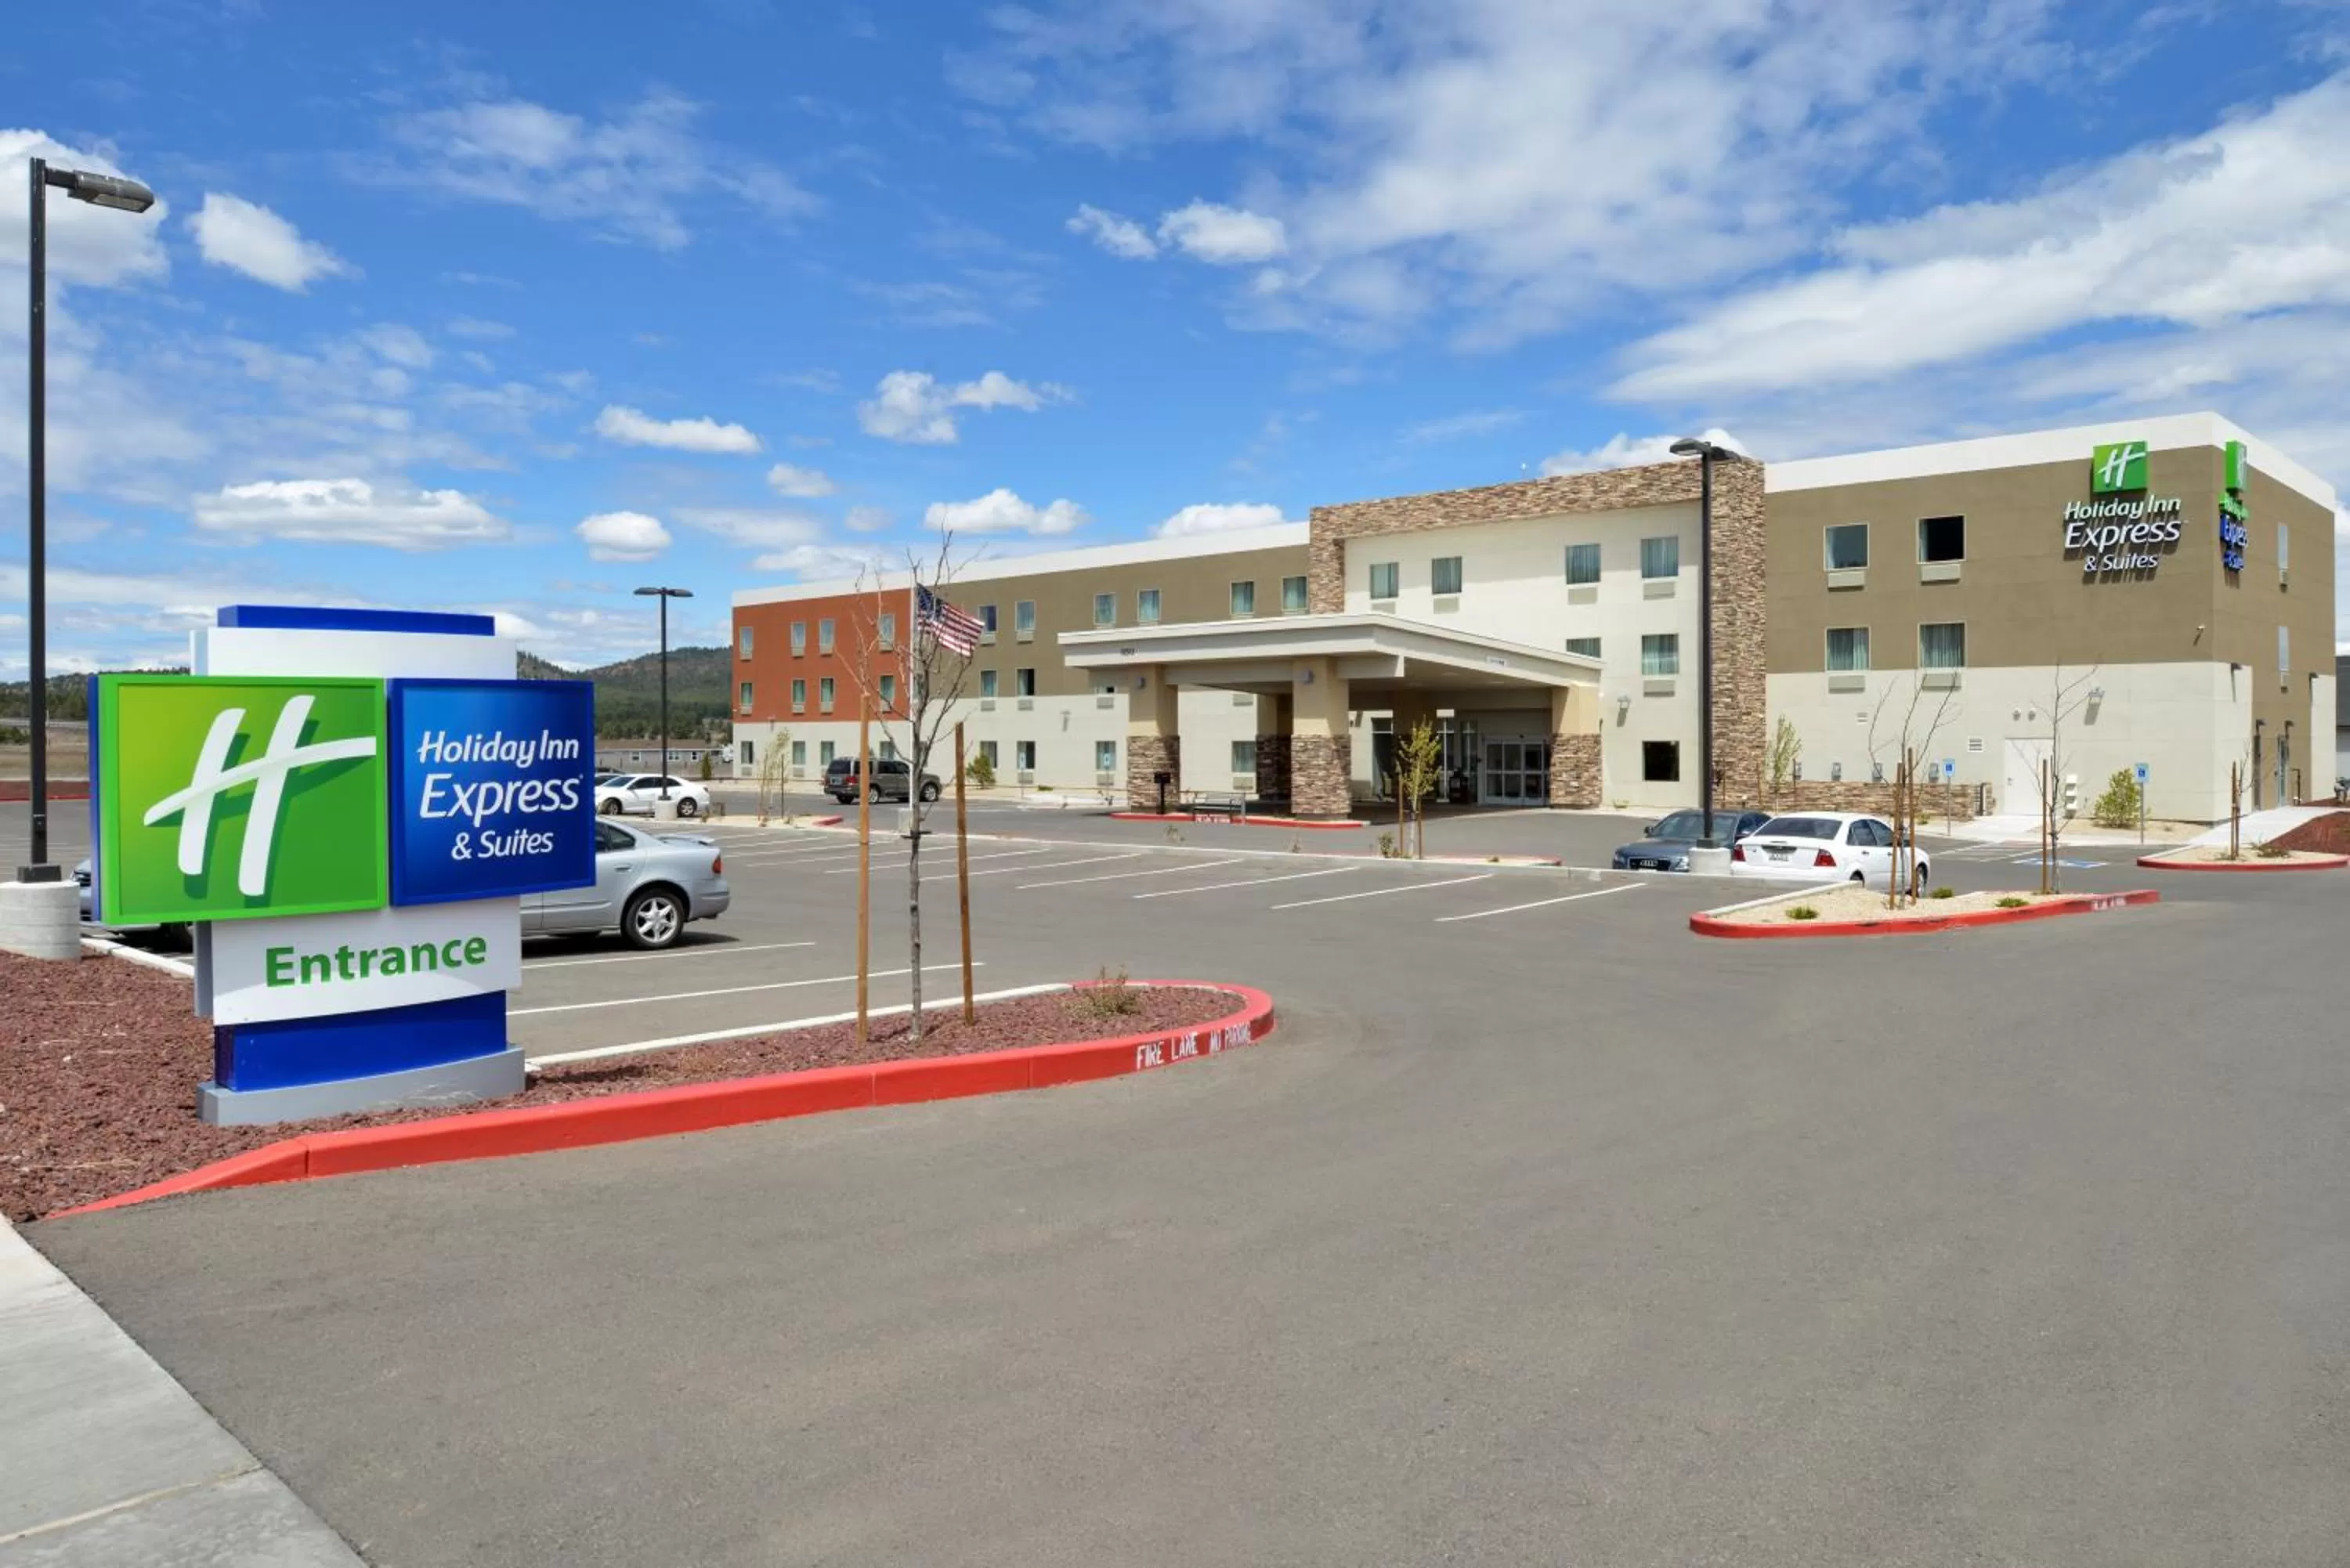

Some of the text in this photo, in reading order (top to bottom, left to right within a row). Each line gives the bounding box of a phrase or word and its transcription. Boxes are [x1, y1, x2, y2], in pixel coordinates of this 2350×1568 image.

[2063, 494, 2182, 520] Holiday Inn
[2064, 520, 2182, 553] Express
[2084, 552, 2158, 572] & Suites
[417, 729, 579, 768] Holiday Inn
[419, 772, 580, 828] Express
[450, 828, 554, 861] & Suites
[266, 937, 486, 988] Entrance
[1137, 1041, 1165, 1070] FIRE
[1171, 1031, 1198, 1060] LANE
